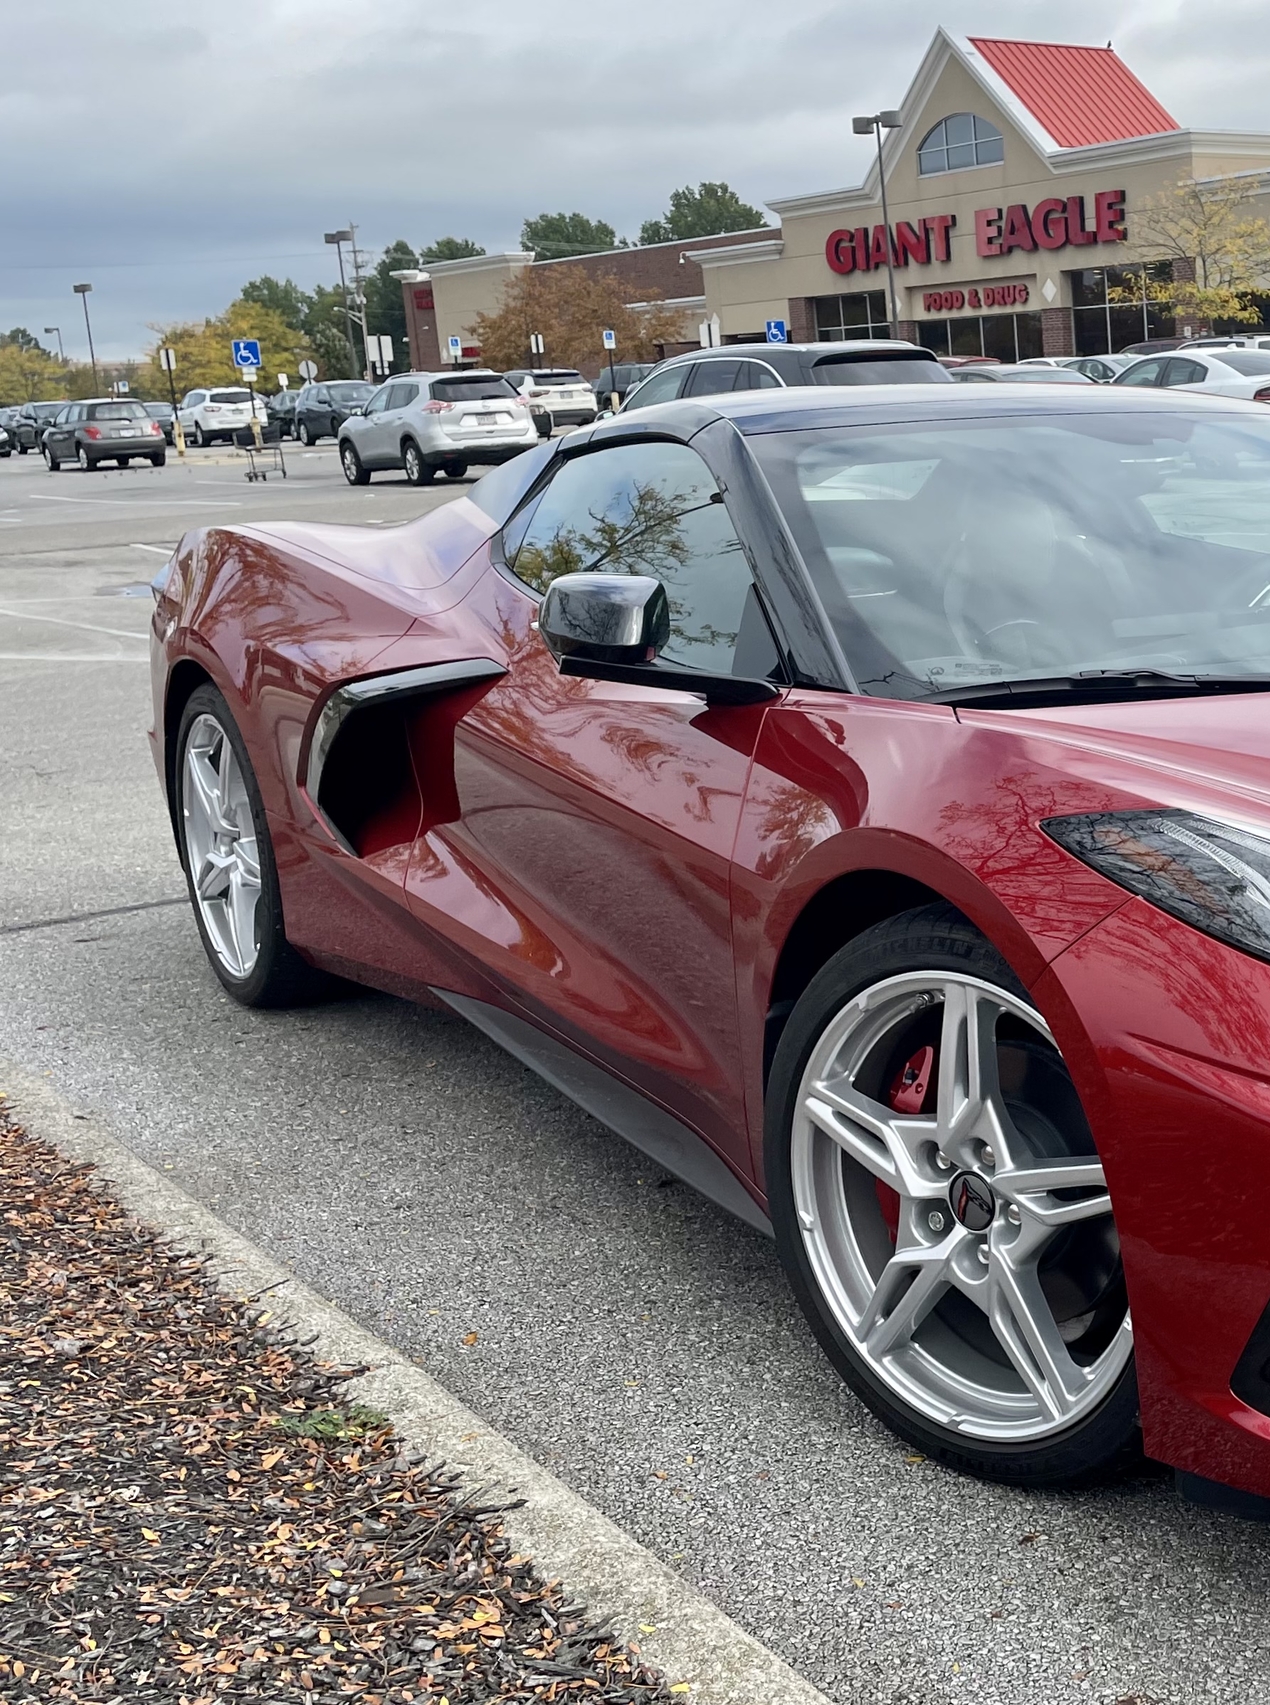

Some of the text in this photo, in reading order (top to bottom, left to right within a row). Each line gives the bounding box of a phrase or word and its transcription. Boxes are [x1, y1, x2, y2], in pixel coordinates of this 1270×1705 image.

[825, 190, 1126, 275] GIANT EAGLE
[923, 284, 1029, 312] FOOD & DRUG
